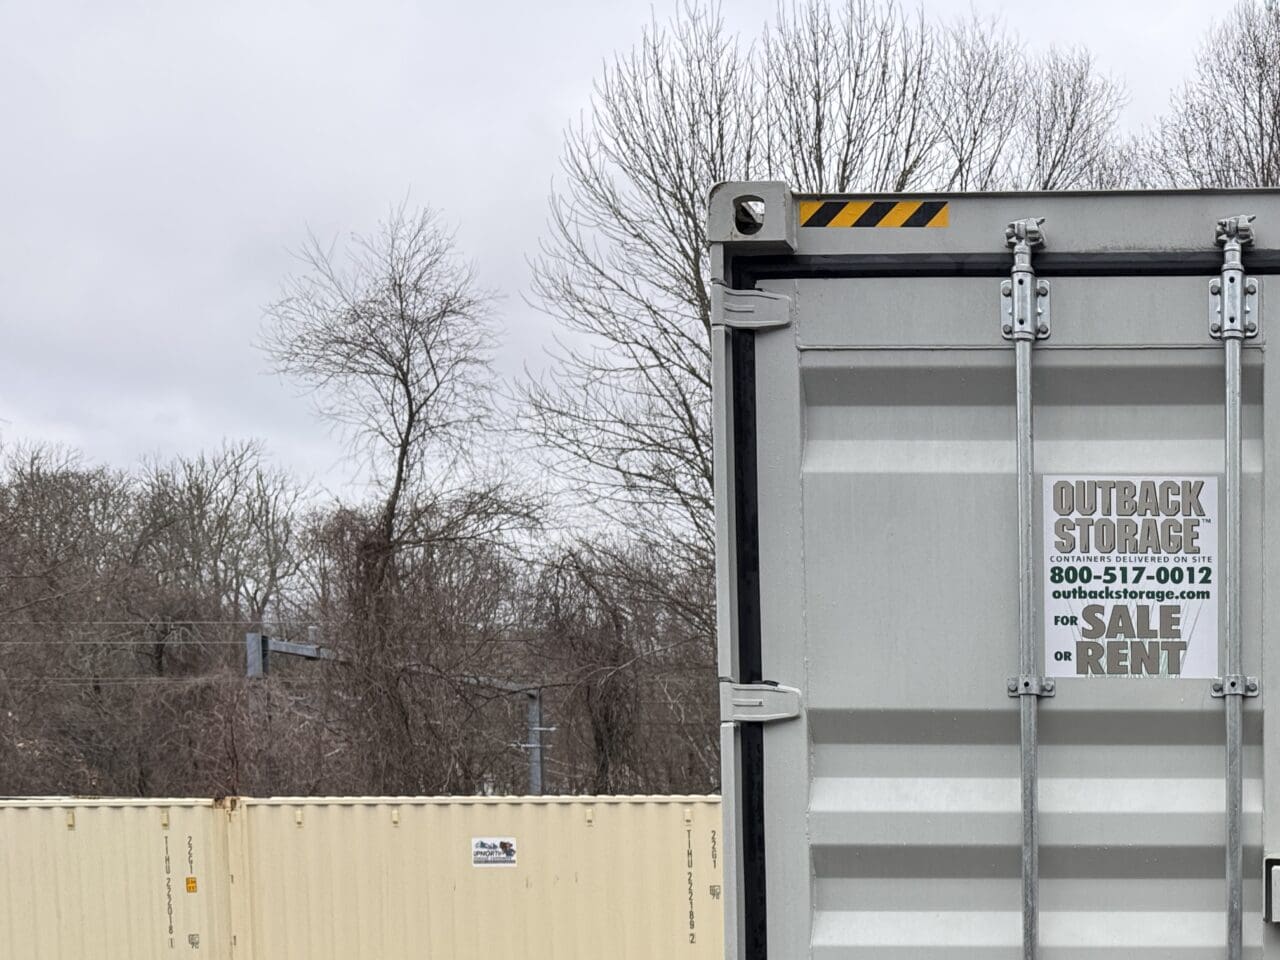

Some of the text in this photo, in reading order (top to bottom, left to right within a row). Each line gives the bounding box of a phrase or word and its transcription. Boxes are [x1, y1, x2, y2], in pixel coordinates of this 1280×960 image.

[1053, 480, 1205, 516] OUTBACK
[1054, 518, 1201, 554] STORAGE
[1050, 566, 1212, 584] 800-517-0012
[1052, 586, 1210, 602] outbackstorage.com
[1054, 604, 1182, 639] FOR SALE
[1054, 641, 1187, 675] OR RENT
